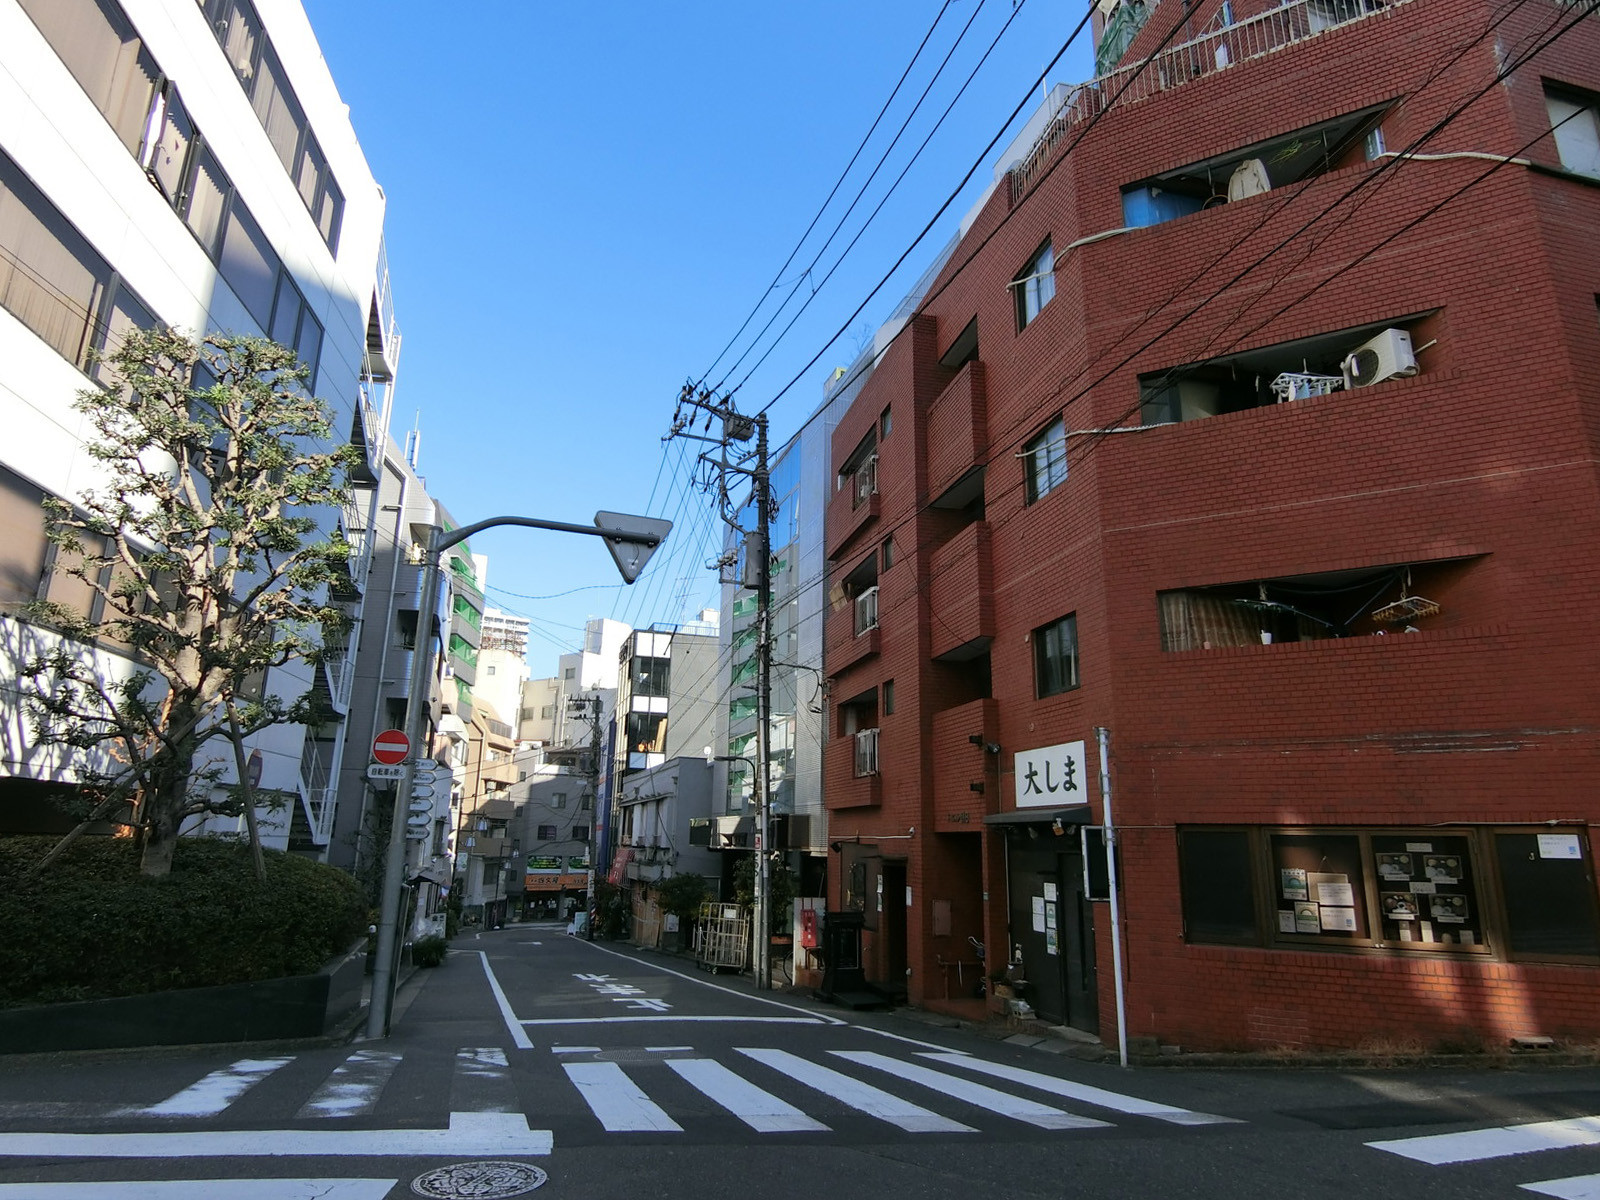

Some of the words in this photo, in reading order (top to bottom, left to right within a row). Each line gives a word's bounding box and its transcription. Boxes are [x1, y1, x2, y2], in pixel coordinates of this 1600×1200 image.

[371, 768, 404, 778] 自転車を除く
[1023, 755, 1078, 796] 大しま
